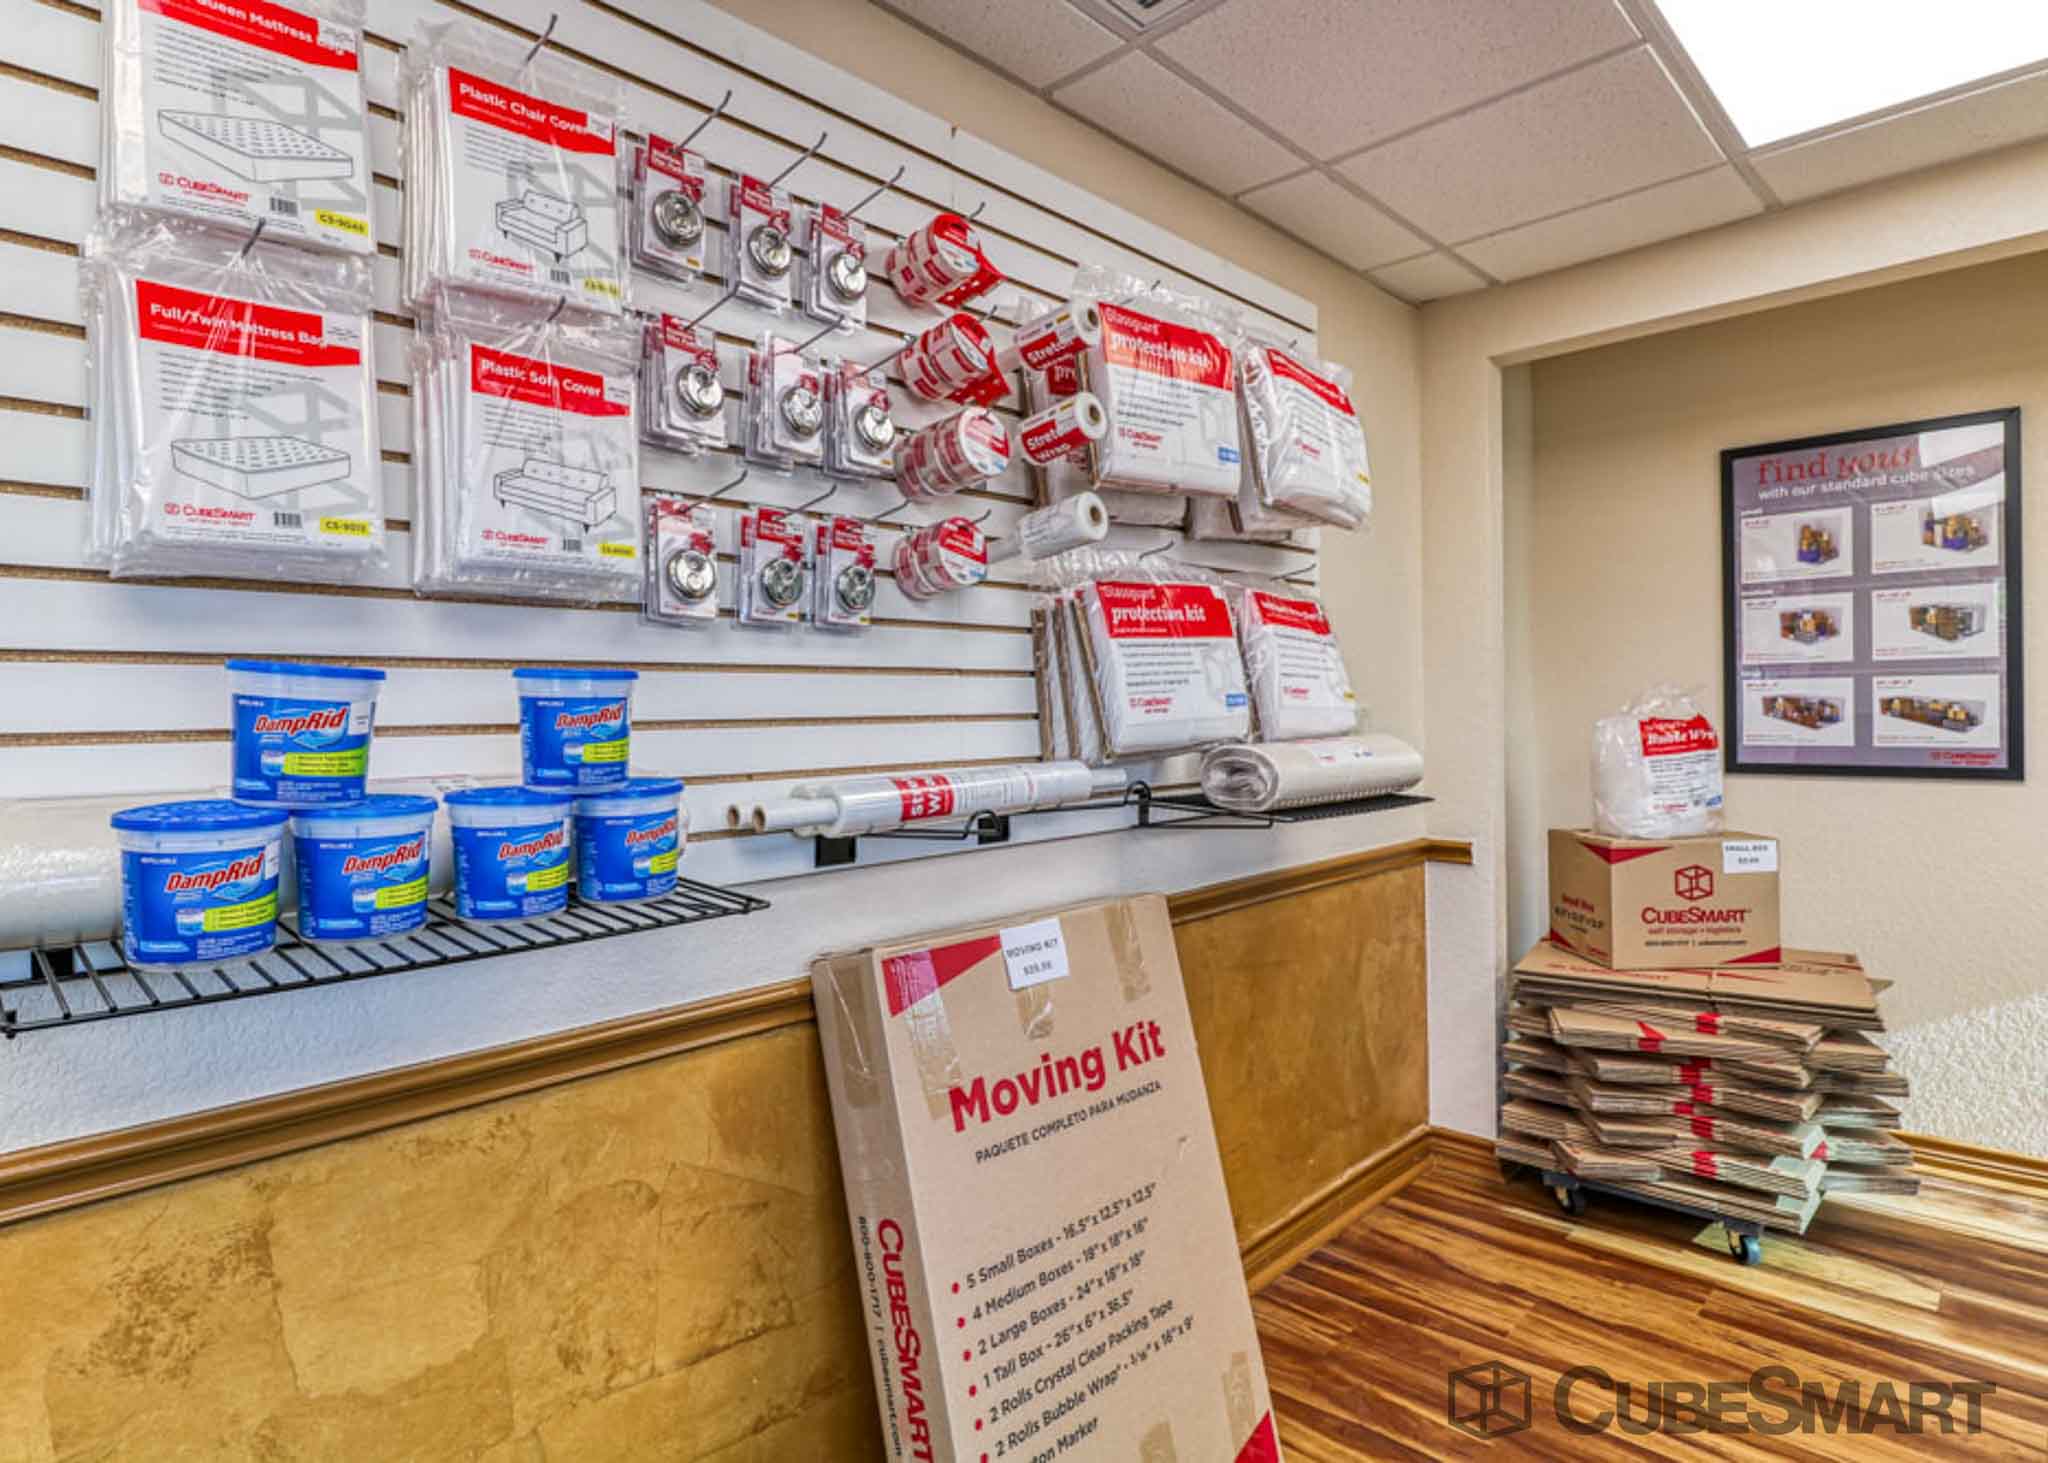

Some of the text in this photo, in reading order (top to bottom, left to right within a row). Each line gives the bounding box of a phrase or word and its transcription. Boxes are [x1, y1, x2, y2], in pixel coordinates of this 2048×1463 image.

[250, 11, 314, 43] Mattress
[459, 82, 507, 110] Plastic
[509, 100, 548, 123] Chair
[150, 303, 228, 328] Full/Twin
[1111, 333, 1186, 365] protection
[479, 358, 527, 381] Plastic
[529, 369, 560, 388] Sofa
[562, 378, 602, 398] Cover
[1758, 448, 1827, 486] find
[1758, 486, 1790, 501] with
[1791, 484, 1816, 497] our
[1820, 472, 1889, 494] standard
[1890, 470, 1929, 487] cube
[1111, 603, 1207, 624] protection kit
[254, 705, 349, 736] DampRid
[555, 701, 626, 730] DampRid
[342, 834, 426, 875] DampRid
[498, 829, 566, 860] DampRid
[164, 851, 265, 893] DampRid
[1641, 906, 1745, 925] CUBESMART
[948, 1020, 1167, 1134] Moving Kit
[975, 1079, 1162, 1164] PAQUETE COMPLETO PARA MUDANZA
[965, 1272, 977, 1290] 5
[978, 1251, 1016, 1284] Small
[1016, 1235, 1055, 1265] Boxes
[1091, 1214, 1099, 1226] x
[1098, 1197, 1125, 1221] 12.5"
[1125, 1197, 1132, 1208] x
[1131, 1181, 1157, 1205] 12.5"
[971, 1305, 982, 1321] 4
[984, 1279, 1037, 1316] Medium
[1038, 1259, 1075, 1288] Boxes
[1101, 1242, 1108, 1253] x
[1125, 1228, 1132, 1239] x
[977, 1338, 988, 1356] 2
[989, 1318, 1028, 1349] Large
[1029, 1296, 1068, 1326] Boxes
[1096, 1277, 1104, 1288] x
[1122, 1263, 1129, 1273] x
[877, 1218, 933, 1463] CUBESMART
[983, 1372, 991, 1388] 1
[992, 1358, 1016, 1381] Tall
[1017, 1347, 1045, 1369] Box
[1075, 1322, 1084, 1334] x
[1099, 1308, 1106, 1320] x
[988, 1299, 1174, 1424] 2 Rolls Crystal Clear Packing Tape
[995, 1440, 1006, 1458] 2
[1007, 1420, 1041, 1450] Rolls
[1042, 1391, 1086, 1428] Bubble
[1153, 1340, 1160, 1352] x
[1178, 1324, 1184, 1335] x
[1056, 1416, 1099, 1455] Marker
